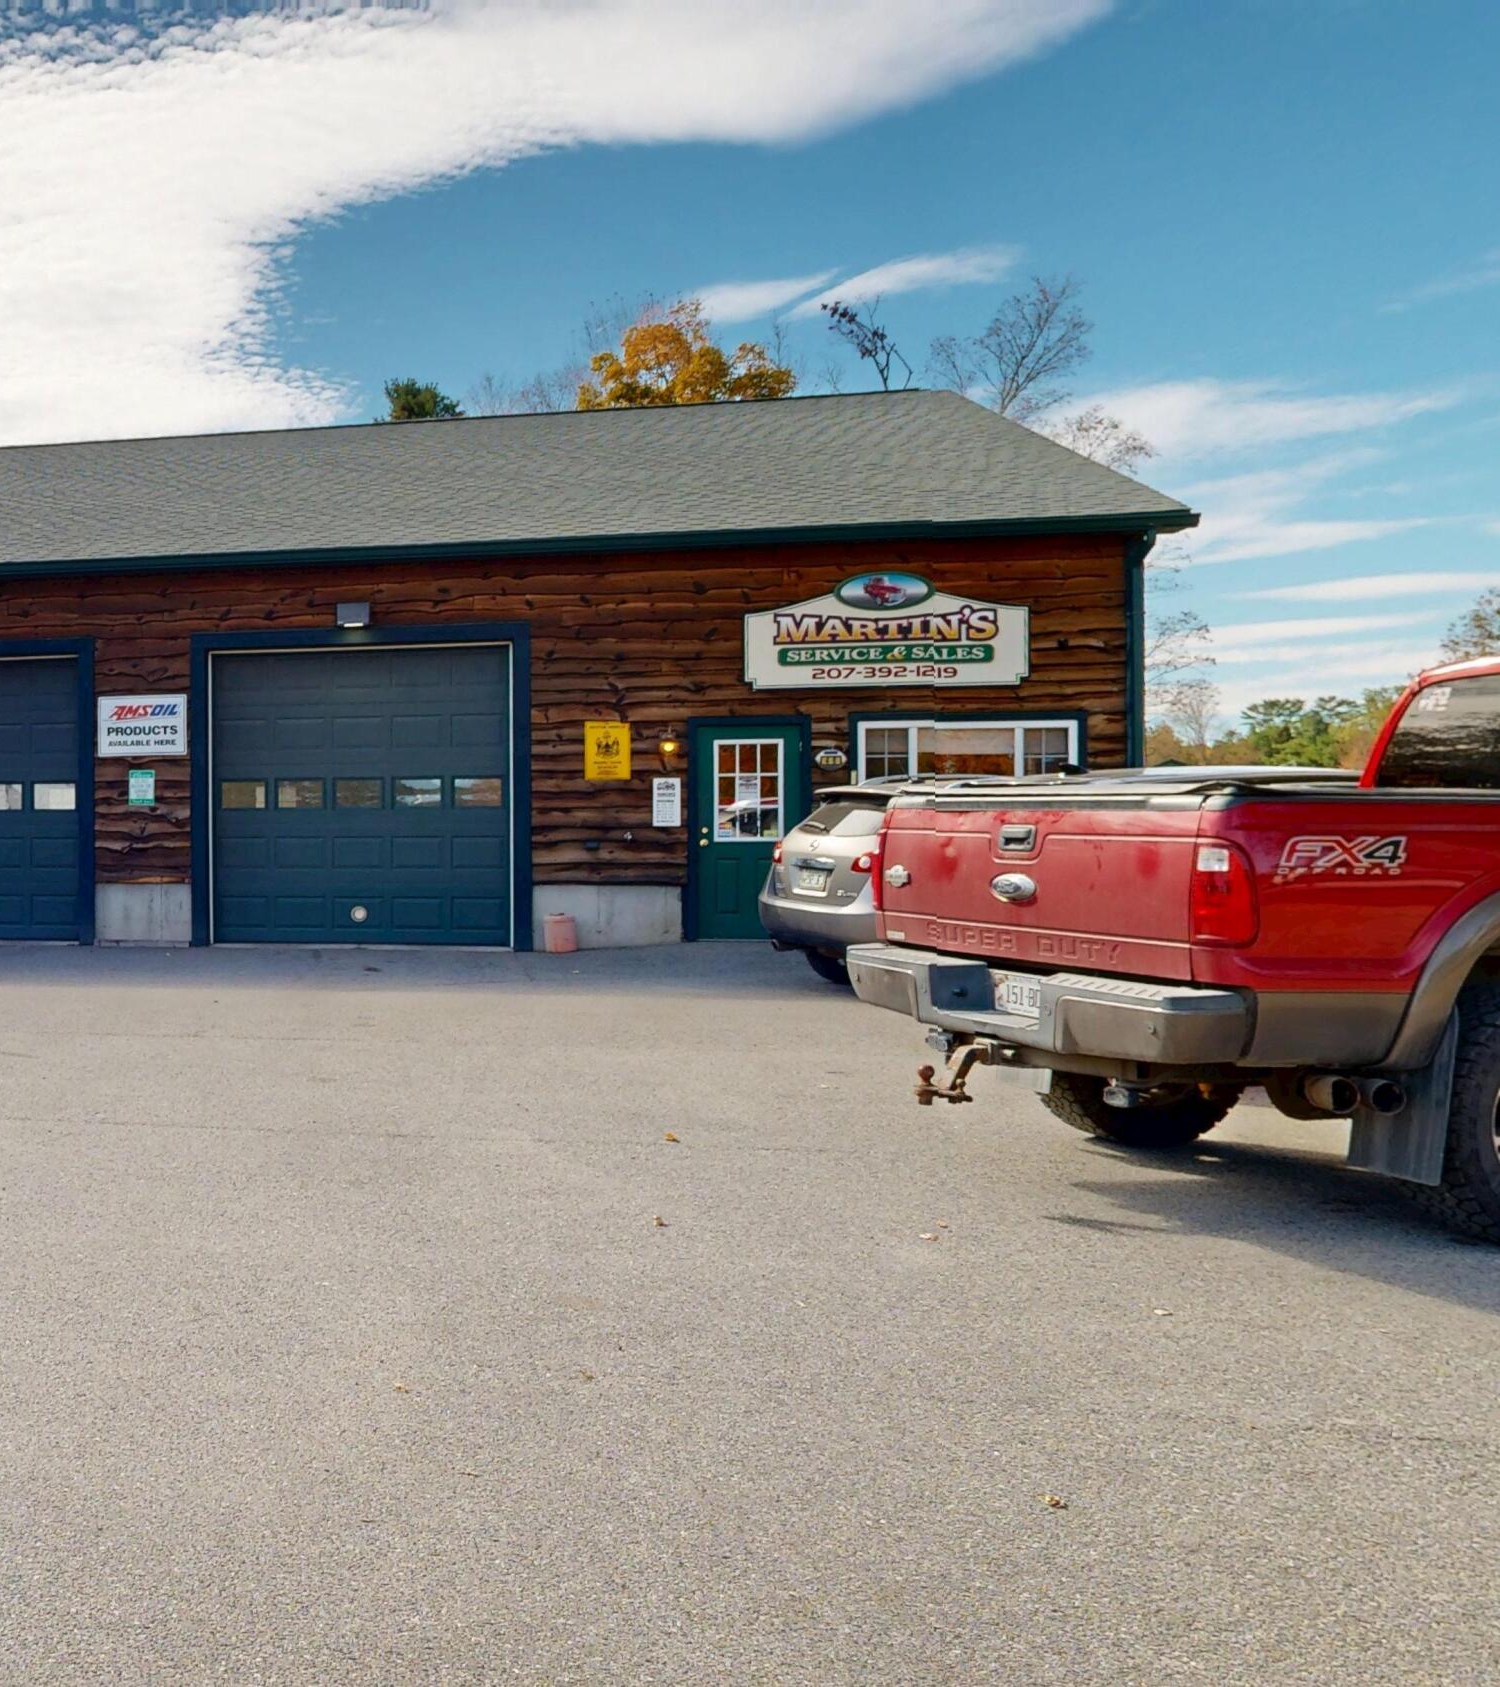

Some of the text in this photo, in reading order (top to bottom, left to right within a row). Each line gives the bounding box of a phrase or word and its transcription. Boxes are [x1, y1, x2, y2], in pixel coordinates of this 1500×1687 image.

[773, 604, 999, 645] MARTIN'S
[786, 645, 985, 662] SERVICE & SALES
[811, 665, 958, 680] 207-392-1219
[108, 703, 178, 721] AMSOIL
[107, 725, 178, 736] PRODUCTS
[108, 739, 151, 747] AVAILABLE
[1279, 835, 1408, 868] FX4
[1334, 867, 1402, 876] ROAD
[926, 920, 1122, 964] SUPER DUTY
